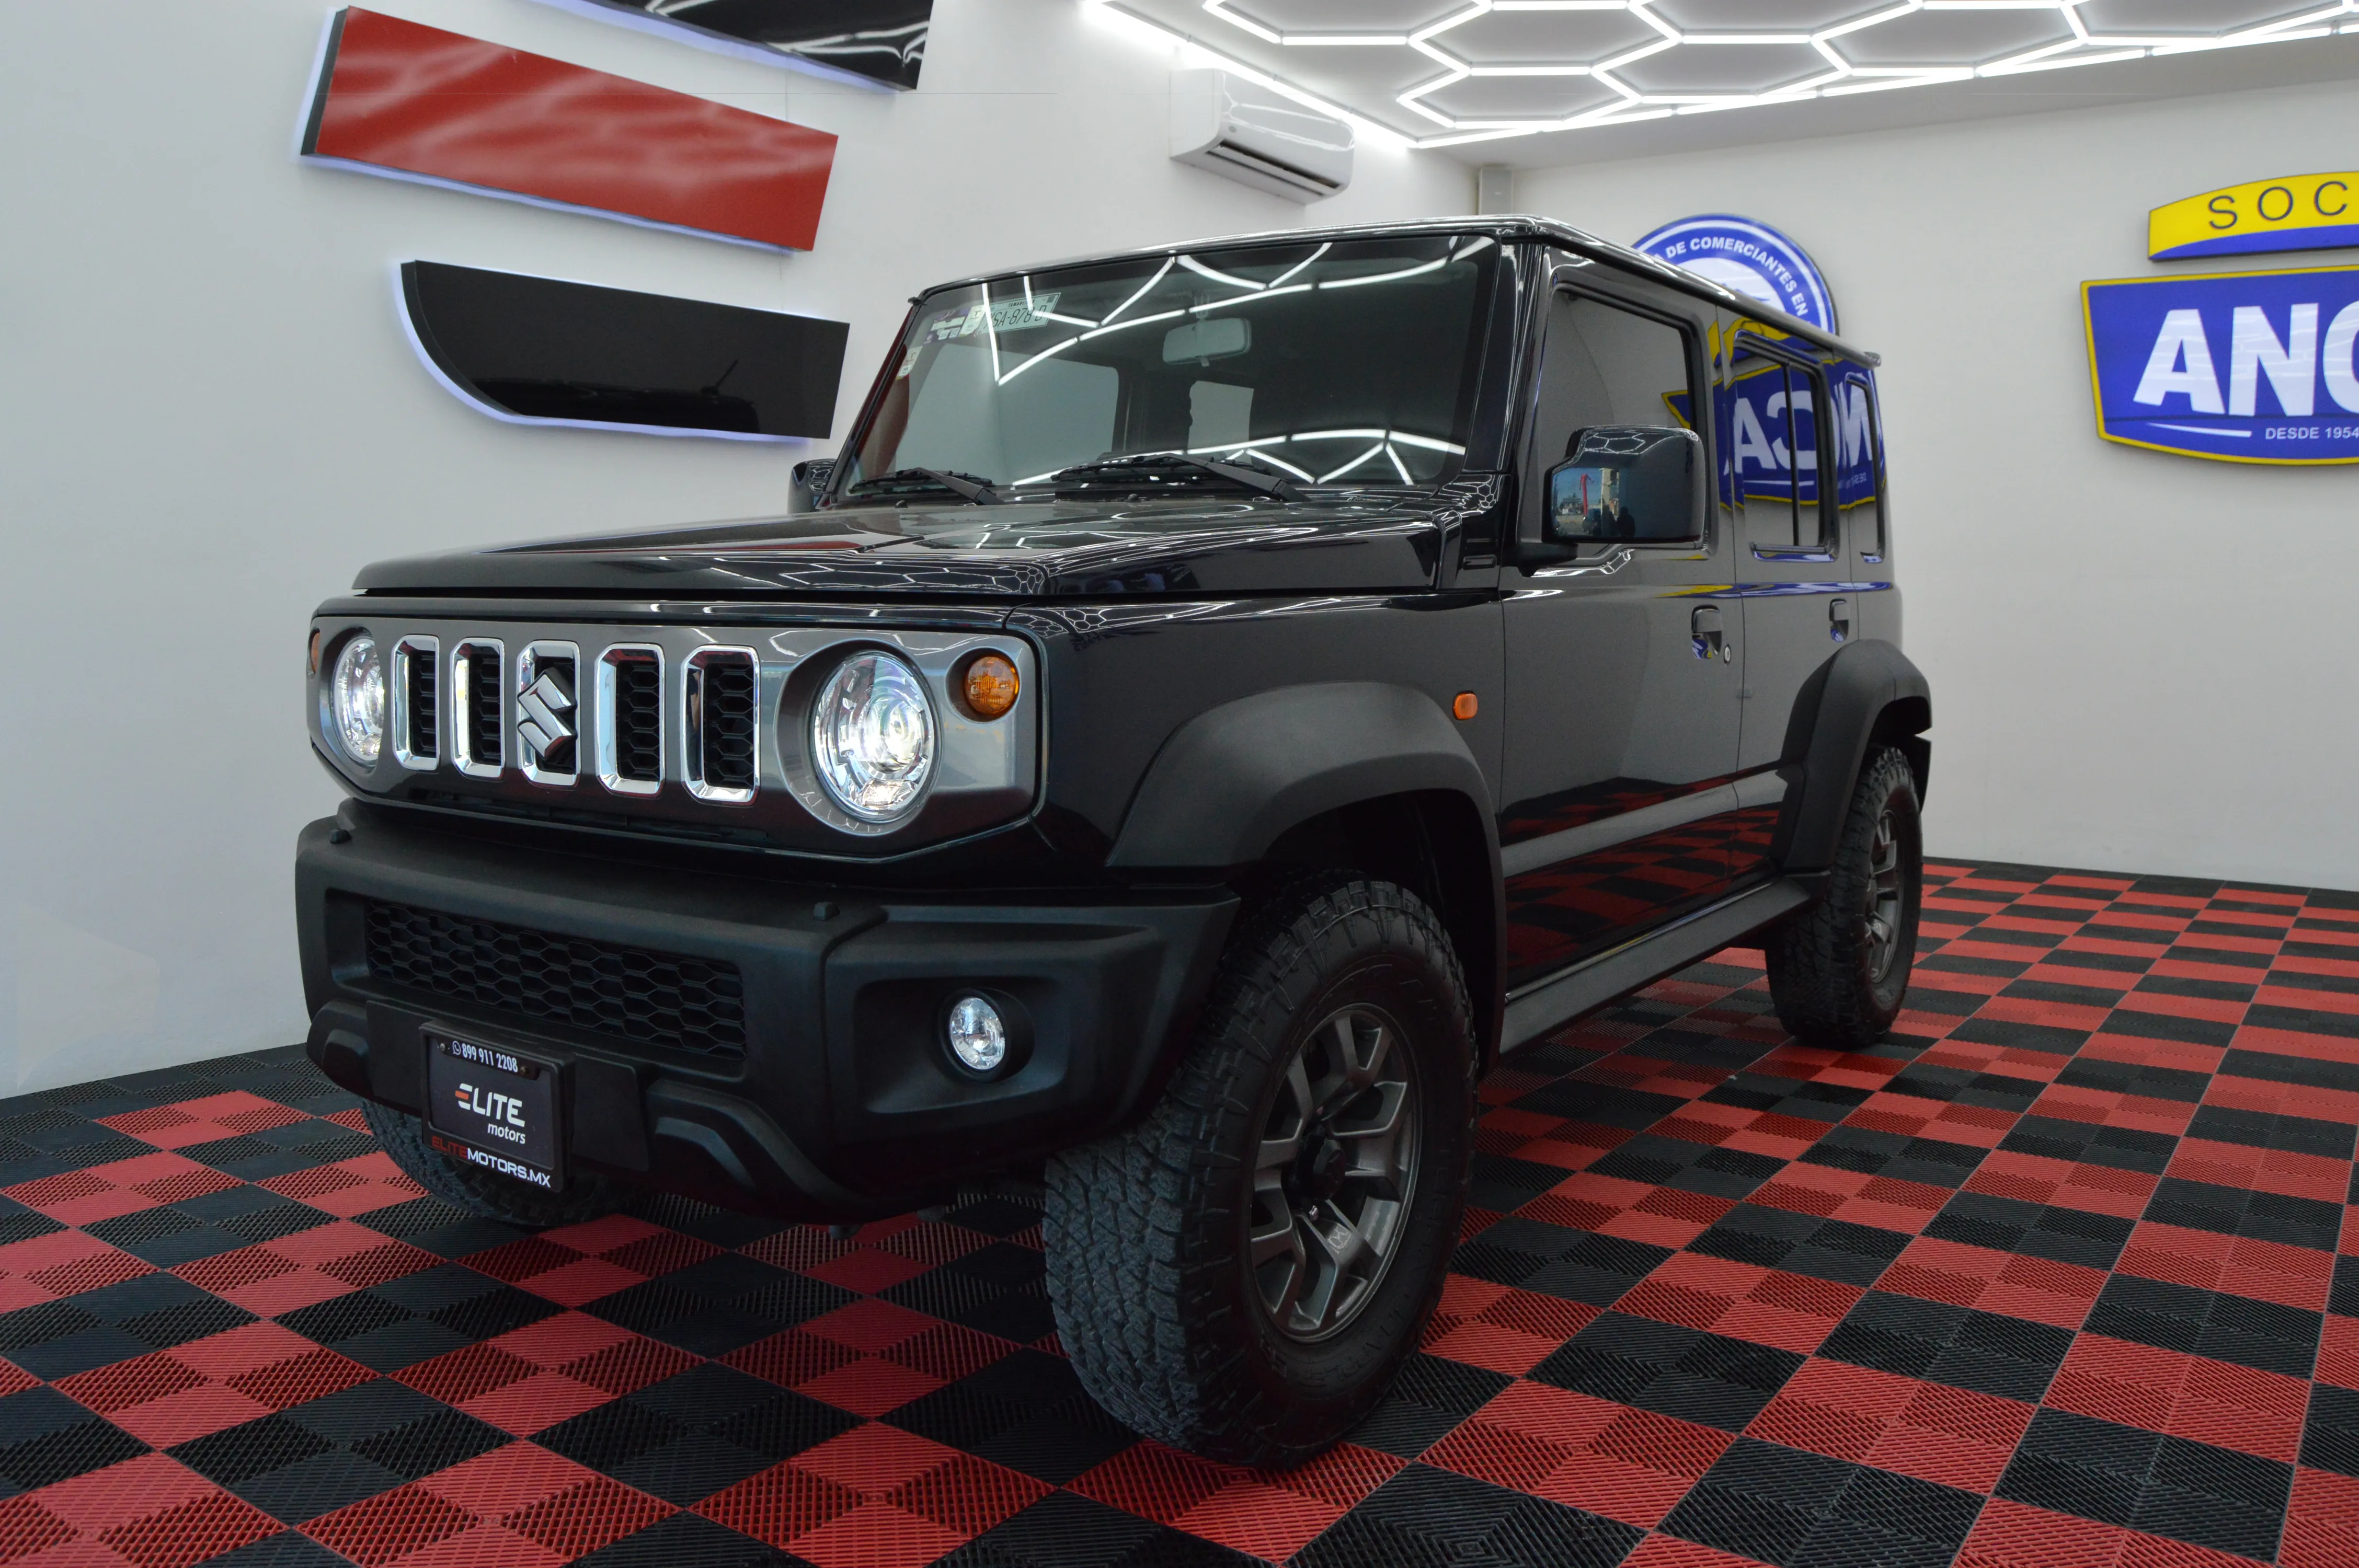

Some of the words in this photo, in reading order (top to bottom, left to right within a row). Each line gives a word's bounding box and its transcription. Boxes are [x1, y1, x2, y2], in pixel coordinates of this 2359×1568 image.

[1665, 241, 1687, 258] DE
[1689, 236, 1798, 293] COMERCIANTES
[1791, 292, 1809, 317] EN
[2265, 426, 2320, 440] DESDE
[2324, 426, 2359, 440] 1954
[462, 1043, 477, 1060] 899
[479, 1048, 494, 1066] 911
[496, 1053, 518, 1073] 2208
[455, 1082, 525, 1127] ELITE
[487, 1123, 526, 1145] motors
[432, 1136, 551, 1187] ELITEMOTORS.MX
